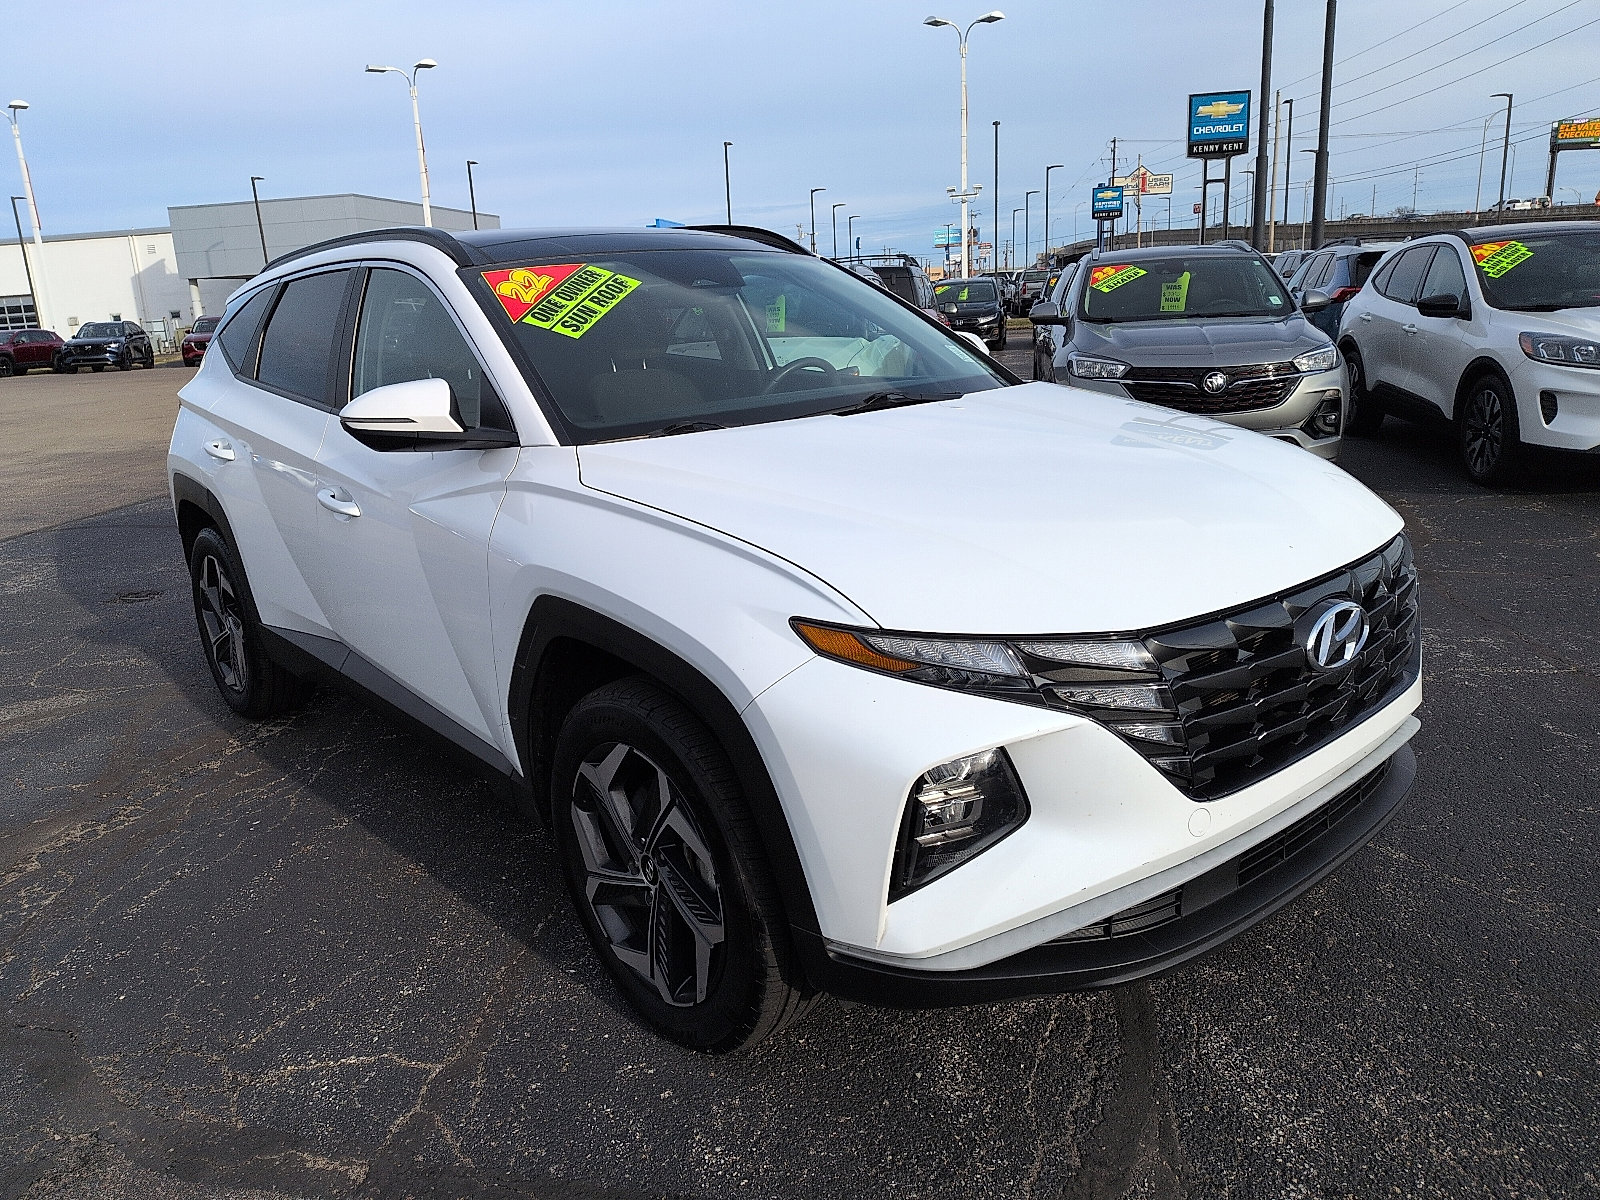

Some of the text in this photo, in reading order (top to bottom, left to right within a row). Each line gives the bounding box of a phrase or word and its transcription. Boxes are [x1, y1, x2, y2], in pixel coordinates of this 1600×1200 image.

[1193, 123, 1244, 134] CHEVROLET
[1557, 130, 1600, 139] CHECKING
[1559, 122, 1600, 132] ELEVATE
[1193, 142, 1243, 153] KENNY KENT
[1482, 243, 1518, 264] HYBRID
[496, 269, 554, 304] 22
[531, 269, 607, 323] ONE OWNER
[560, 277, 633, 333] SUN ROOF
